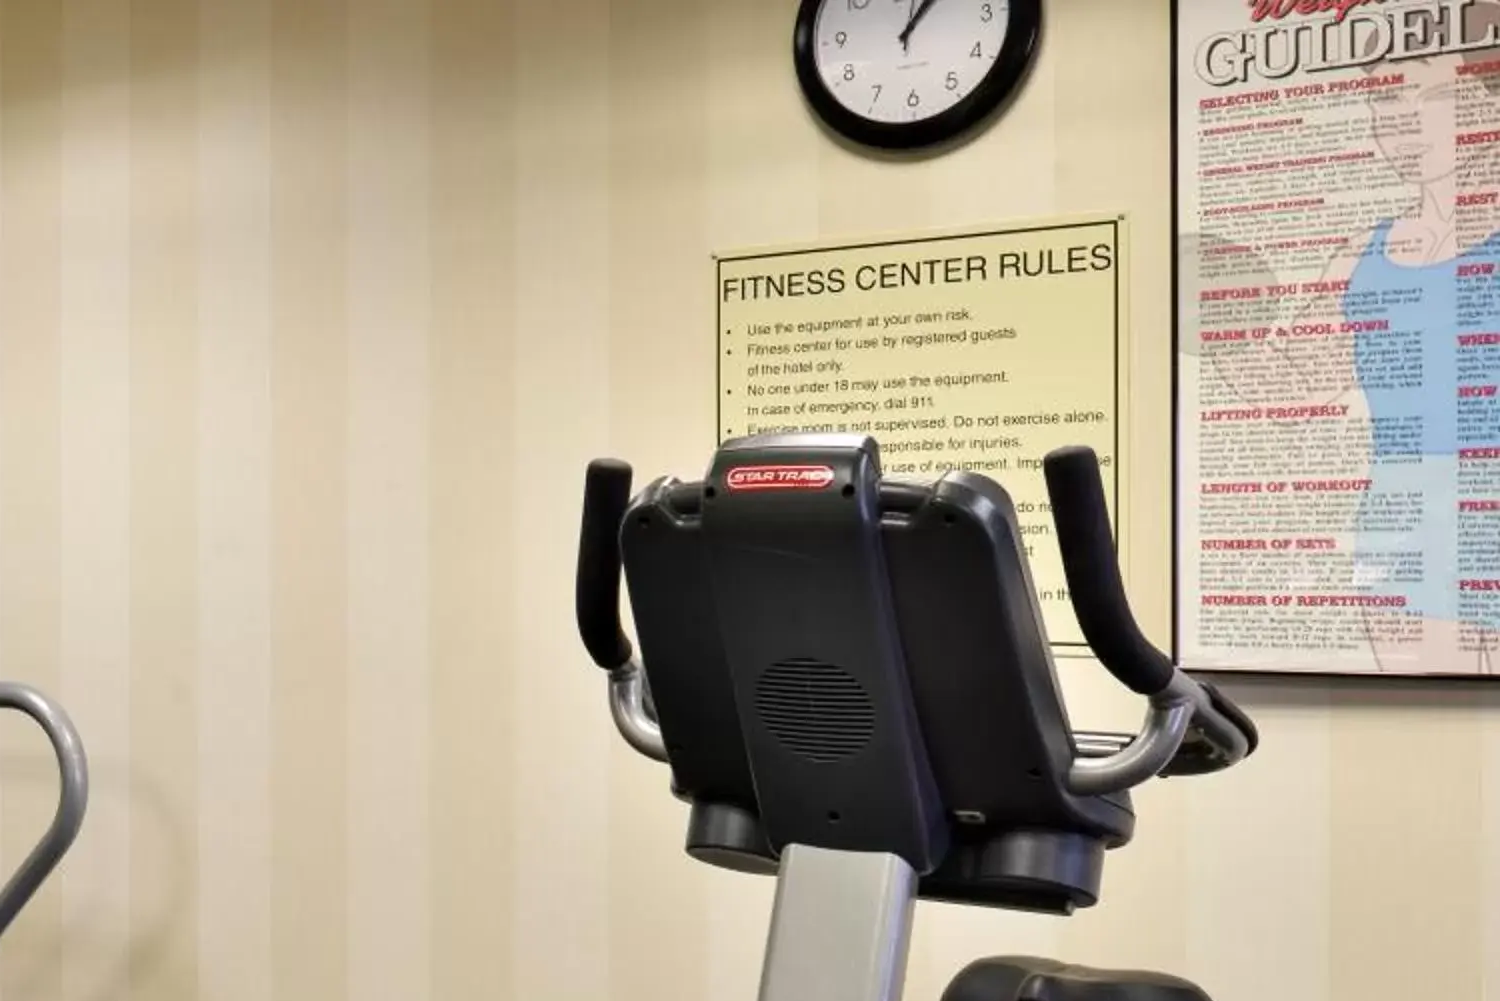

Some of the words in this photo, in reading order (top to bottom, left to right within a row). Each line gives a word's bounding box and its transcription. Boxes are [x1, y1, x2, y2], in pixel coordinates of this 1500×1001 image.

[980, 4, 993, 23] 3
[835, 31, 847, 48] 9
[970, 41, 982, 59] 4
[843, 64, 855, 81] 8
[945, 71, 959, 90] 5
[871, 85, 882, 103] 7
[907, 89, 919, 107] 6
[1199, 90, 1279, 109] SELECTING
[1284, 84, 1325, 99] YOUR
[1328, 74, 1404, 93] PROGRAM
[723, 268, 845, 302] FITNESS
[855, 255, 987, 291] CENTER
[999, 243, 1112, 279] RULES
[1201, 287, 1260, 301] BEFORE
[1267, 285, 1297, 297] YOU
[1301, 280, 1351, 294] START
[747, 324, 771, 336] Use
[775, 322, 793, 334] the
[798, 317, 862, 334] equipment
[867, 315, 879, 326] at
[883, 313, 911, 328] your
[914, 312, 942, 323] own
[1201, 329, 1246, 342] WARM
[1252, 327, 1271, 339] UP
[1292, 323, 1335, 337] COOL
[1340, 320, 1389, 333] DOWN
[747, 343, 791, 356] Fitness
[794, 339, 832, 353] center
[835, 337, 852, 350] for
[856, 337, 878, 348] use
[883, 334, 897, 348] by
[901, 330, 967, 347] registered
[971, 327, 1017, 344] guests
[748, 365, 759, 377] of
[761, 364, 781, 375] the
[784, 361, 813, 374] hotel
[747, 385, 764, 396] No
[767, 386, 791, 395] one
[794, 383, 829, 394] under
[835, 379, 849, 391] 18
[852, 381, 878, 394] may
[883, 378, 905, 389] use
[909, 375, 930, 386] the
[935, 371, 1010, 386] equipment.
[747, 405, 758, 416] In
[762, 405, 790, 415] case
[794, 403, 806, 415] of
[884, 397, 906, 409] dial
[1201, 409, 1261, 422] LIFTING
[1266, 405, 1349, 419] PROPERLY
[838, 422, 847, 432] is
[852, 420, 871, 431] not
[875, 415, 949, 433] supervised.
[953, 416, 973, 427] Do
[977, 415, 999, 427] not
[1003, 412, 1060, 425] exercise
[1064, 409, 1109, 424] alone.
[948, 438, 965, 450] for
[969, 436, 1023, 452] injuries.
[892, 462, 918, 472] use
[920, 459, 933, 472] of
[733, 471, 774, 483] STAR
[1201, 482, 1262, 494] LENGTH
[1267, 481, 1287, 492] OF
[1292, 479, 1373, 492] WORKOUT
[1017, 502, 1035, 513] do
[1201, 539, 1267, 550] NUMBER
[1271, 538, 1292, 550] OF
[1296, 538, 1336, 549] SETS
[1201, 595, 1267, 606] NUMBER
[1272, 595, 1292, 606] OF
[1298, 595, 1407, 607] REPETITIONS
